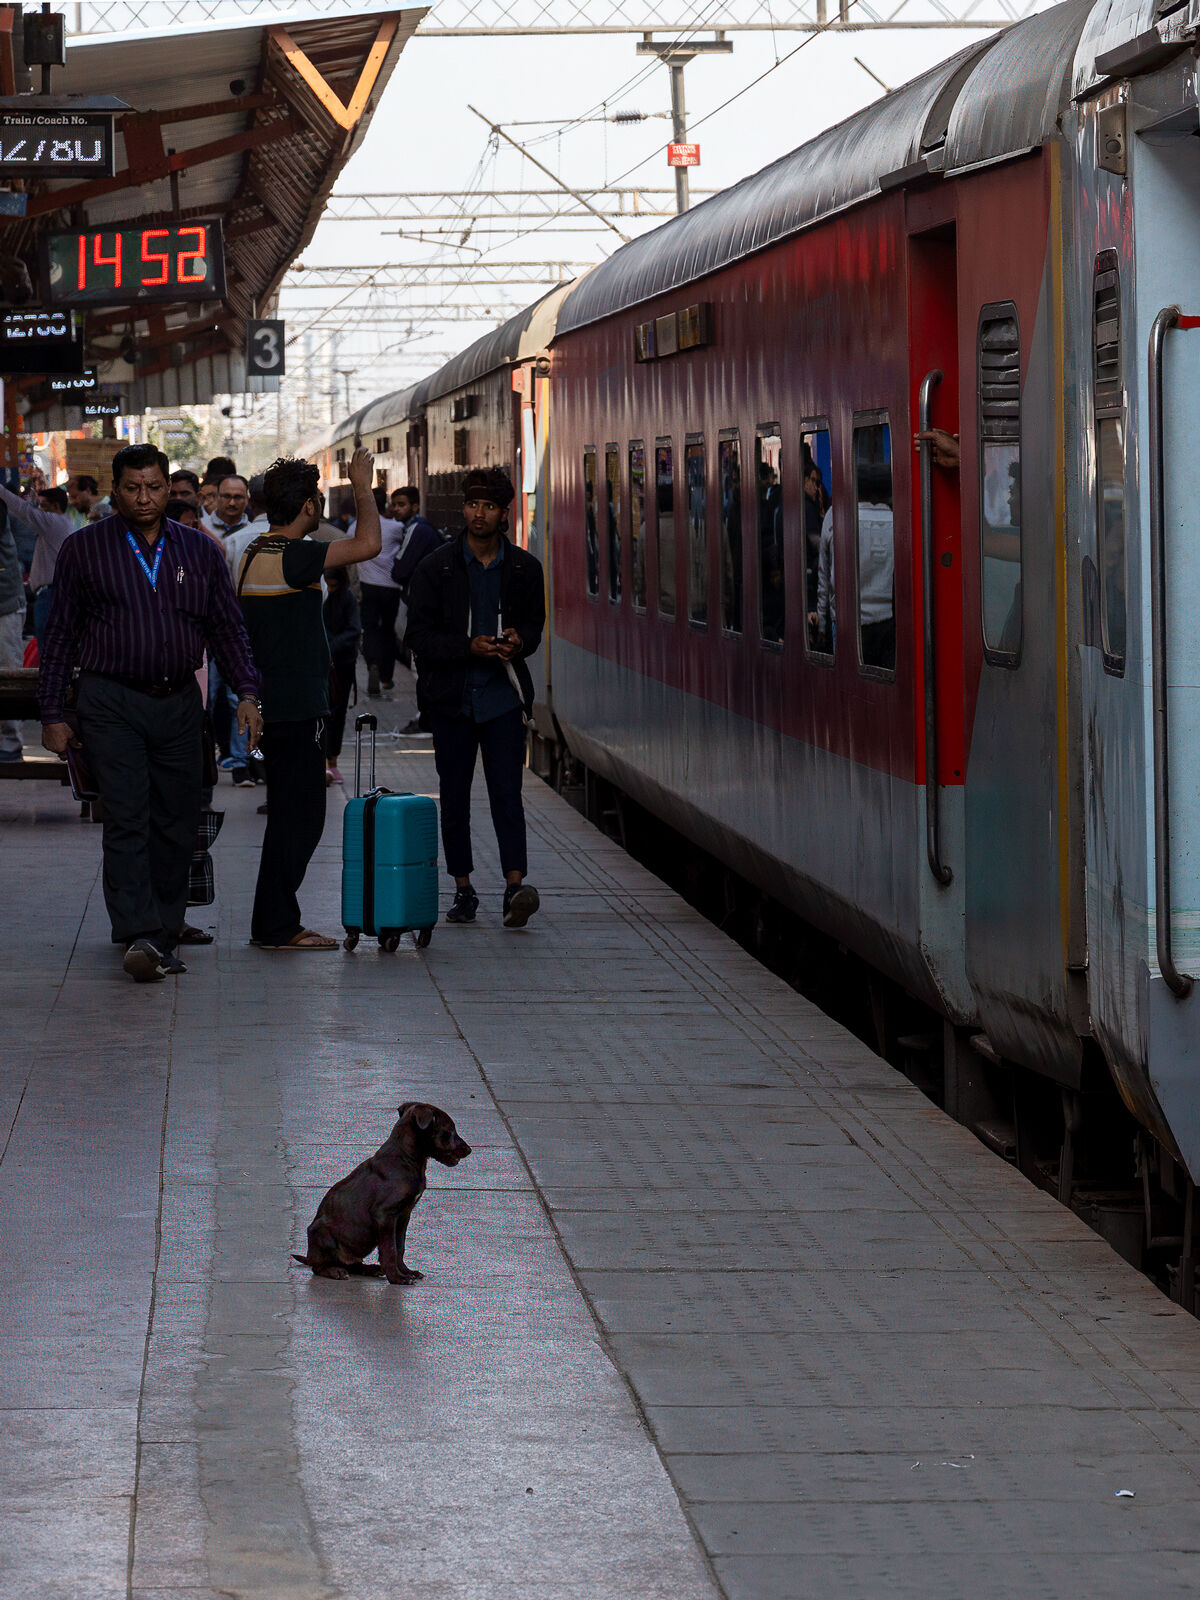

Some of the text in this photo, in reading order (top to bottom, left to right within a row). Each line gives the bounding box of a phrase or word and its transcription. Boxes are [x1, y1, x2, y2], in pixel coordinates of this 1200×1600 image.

[3, 116, 88, 125] Train/Coach No.
[253, 327, 281, 370] 3
